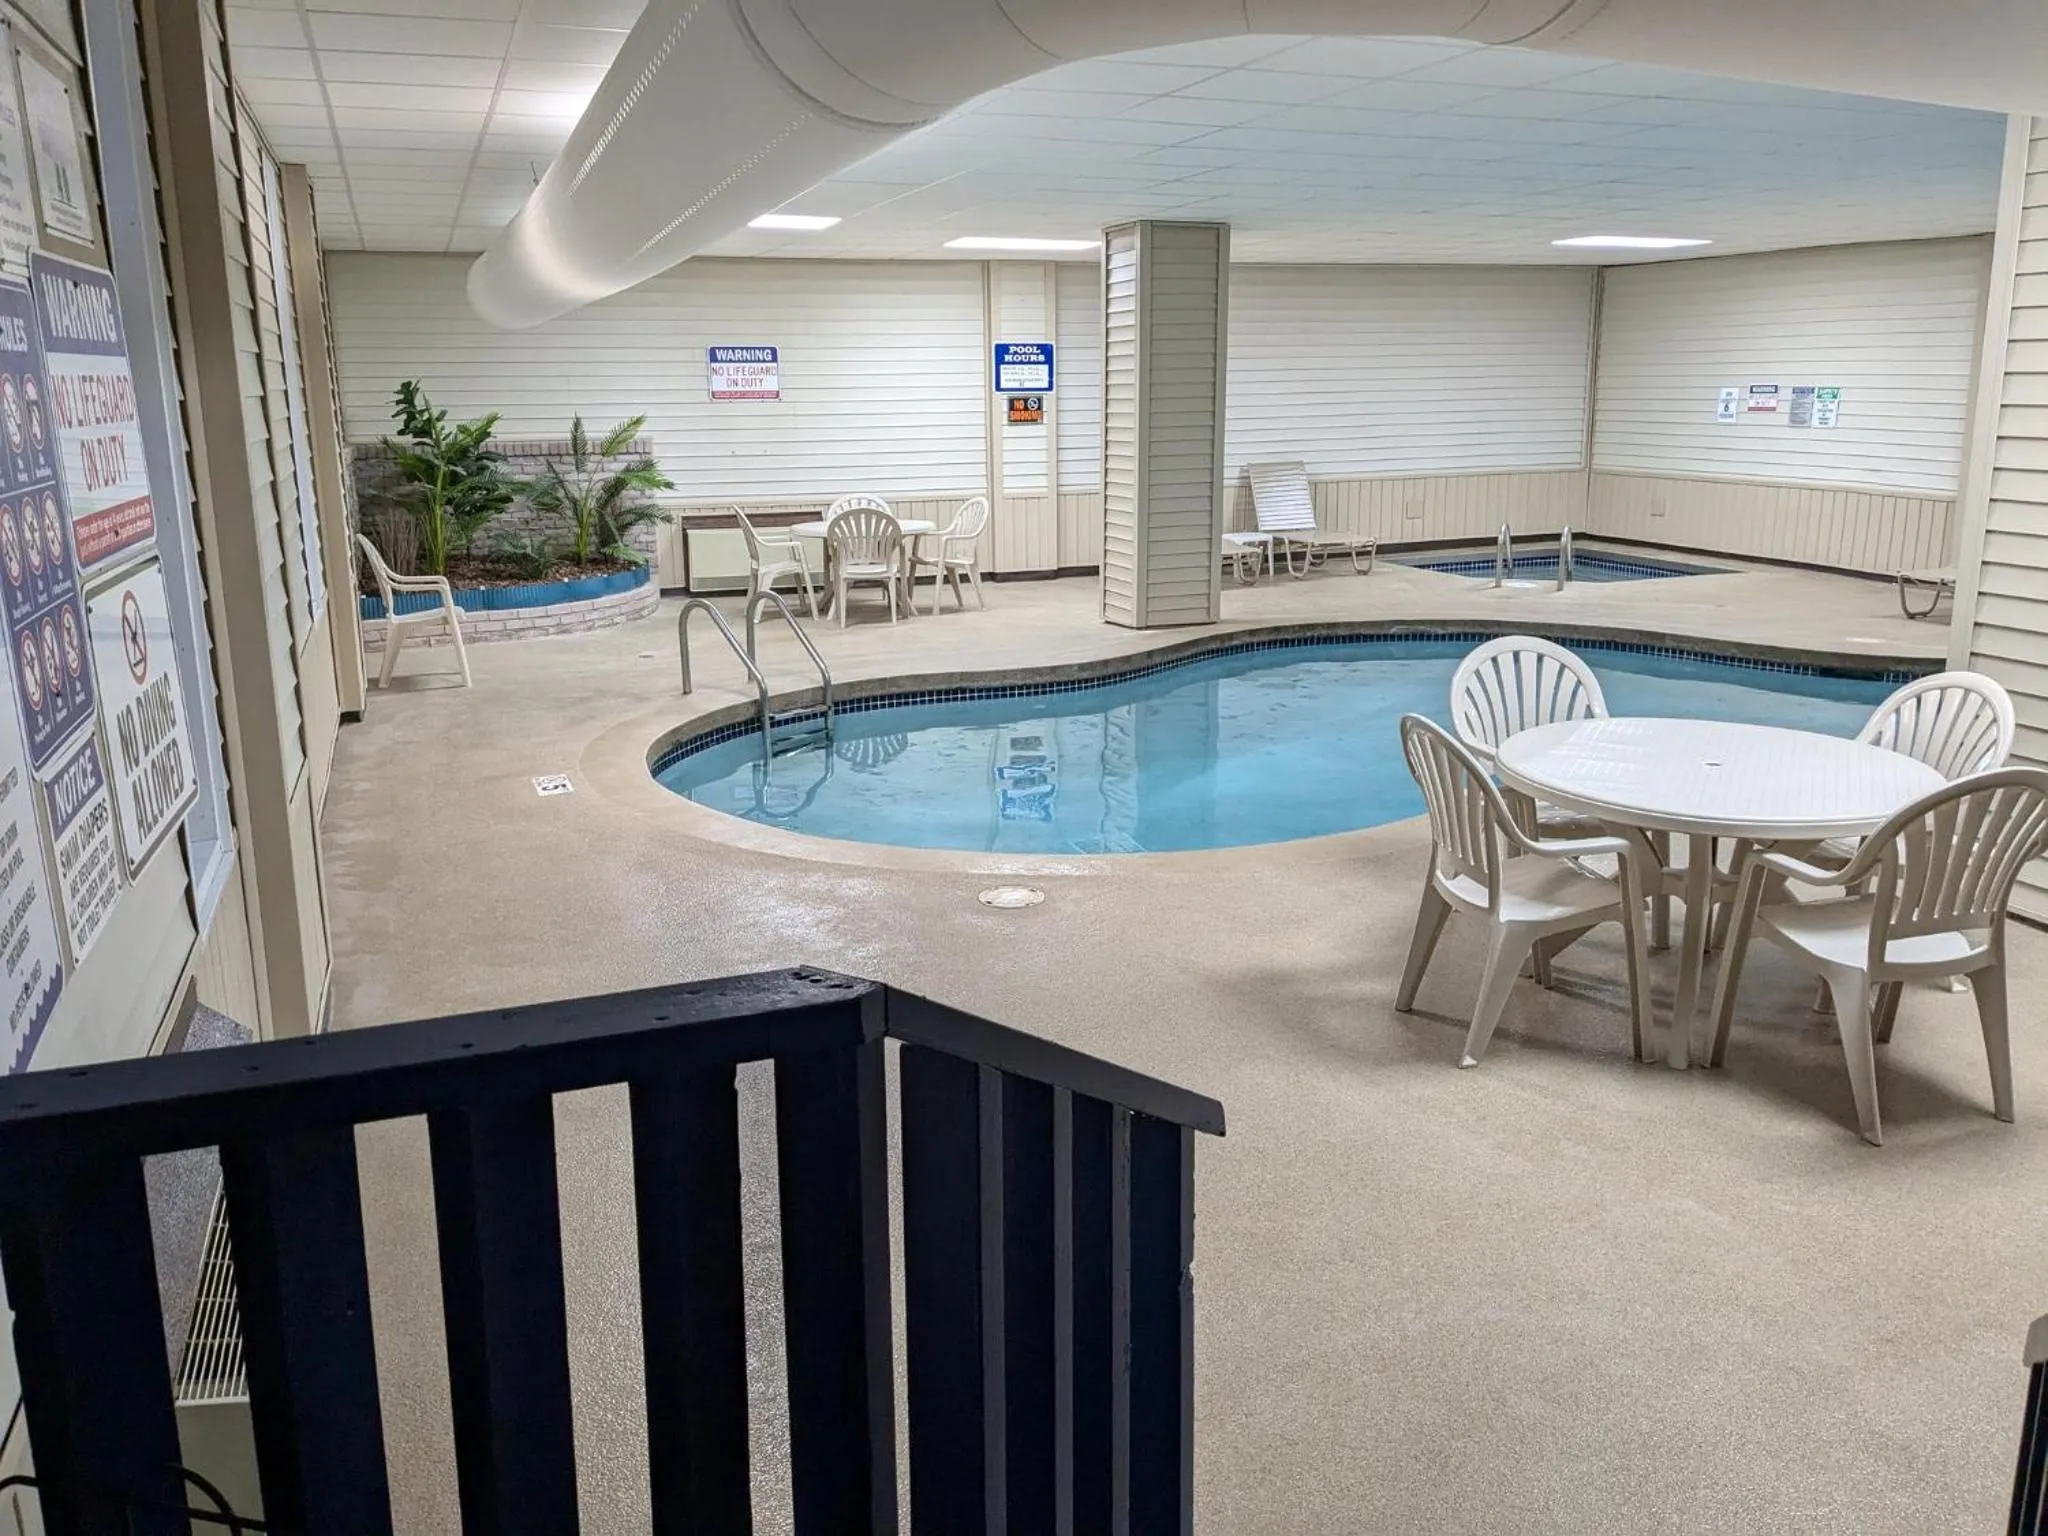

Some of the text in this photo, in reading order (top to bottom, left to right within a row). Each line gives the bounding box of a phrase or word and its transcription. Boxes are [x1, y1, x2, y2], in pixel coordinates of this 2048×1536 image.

[41, 272, 118, 343] WARNING
[712, 366, 777, 377] NO LIFEGUARD
[715, 348, 773, 361] WARNING
[1003, 354, 1046, 363] HOURS
[1008, 346, 1041, 354] POOL
[51, 373, 137, 429] NO LIFEGUARD
[741, 377, 764, 388] DUTY
[80, 438, 100, 493] ON
[97, 433, 129, 488] DUTY
[116, 671, 178, 779] NO DIVING
[53, 746, 97, 828] NOTICE
[131, 737, 185, 846] ALLOWED
[60, 798, 109, 880] SWIM DIAPERS
